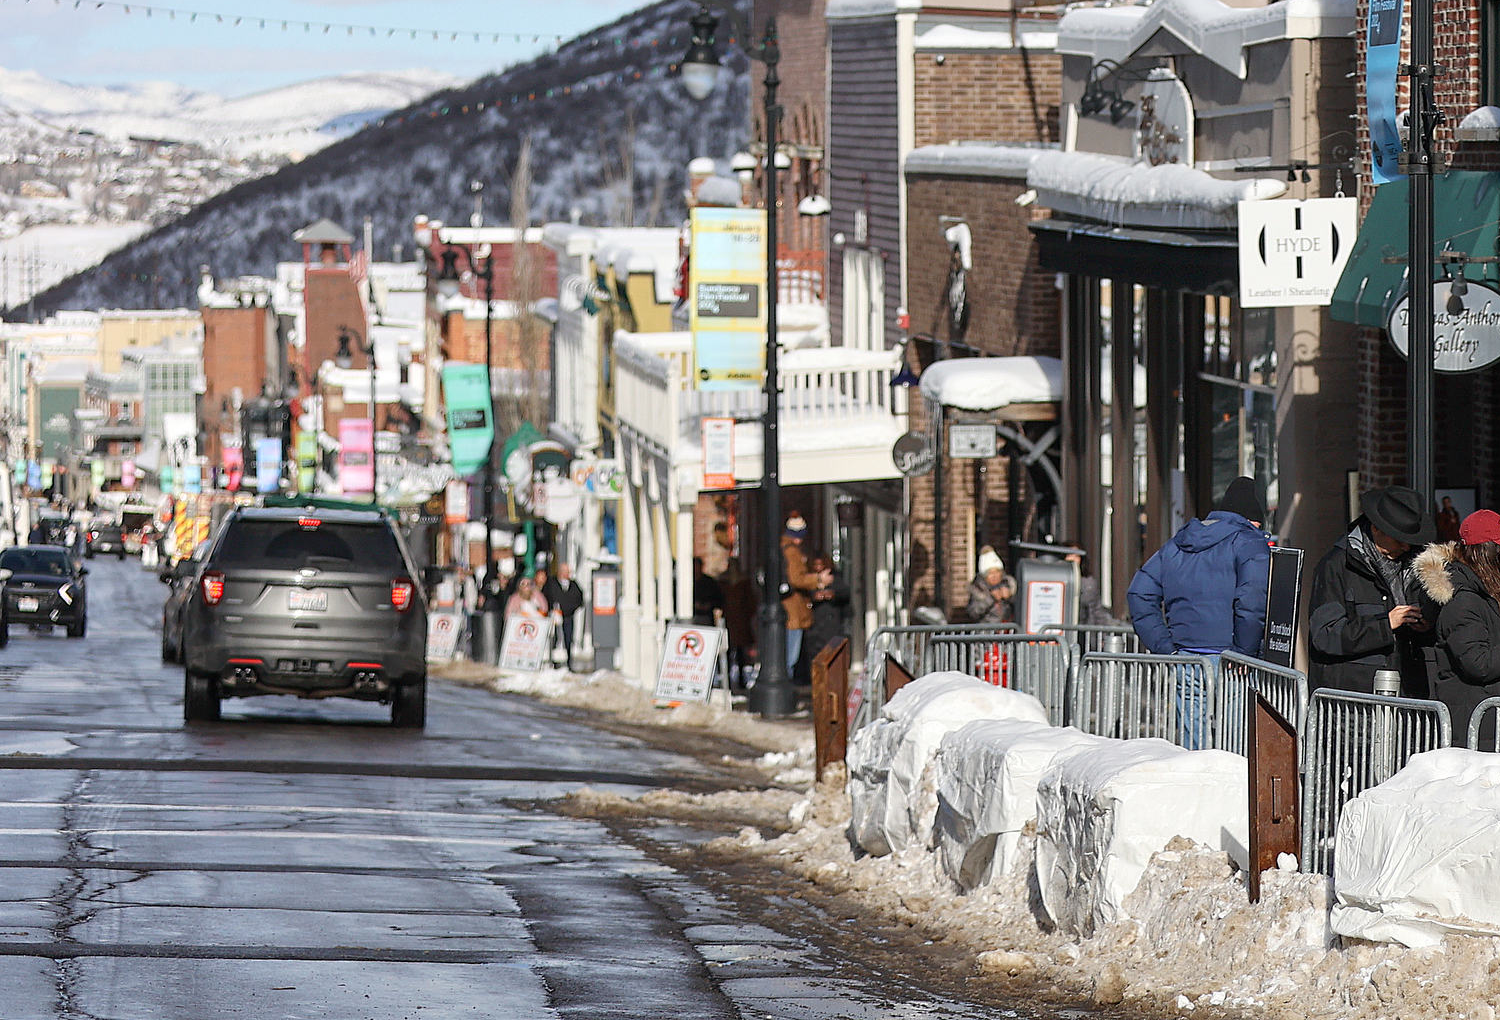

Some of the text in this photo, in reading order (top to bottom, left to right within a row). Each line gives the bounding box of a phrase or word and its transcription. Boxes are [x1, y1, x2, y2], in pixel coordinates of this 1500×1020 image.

[1276, 237, 1321, 252] HYDE
[1248, 286, 1331, 297] Leather Shearling
[1432, 327, 1480, 363] Gallery
